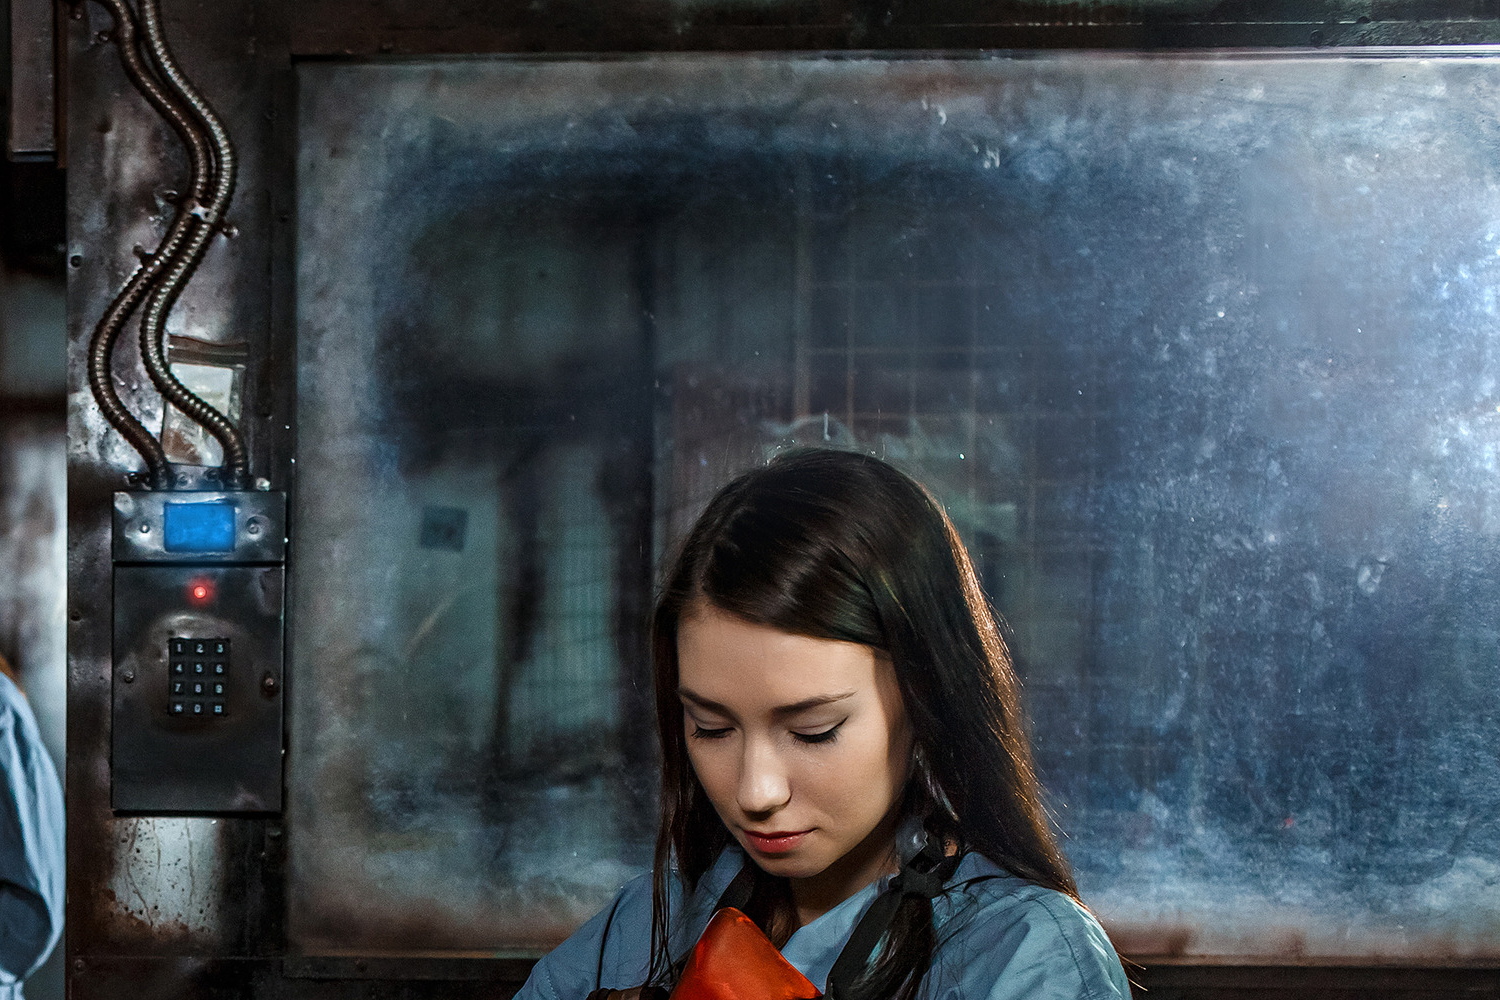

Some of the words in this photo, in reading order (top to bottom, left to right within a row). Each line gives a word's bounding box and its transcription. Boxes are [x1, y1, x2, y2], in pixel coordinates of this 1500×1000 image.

[177, 643, 182, 653] 1
[196, 643, 204, 653] 2
[216, 643, 224, 653] 3
[176, 663, 183, 673] 4
[195, 663, 203, 673] 5
[215, 663, 223, 674] 6
[175, 683, 182, 693] 7
[195, 683, 202, 693] 8
[215, 684, 223, 694] 9
[194, 703, 201, 713] 0
